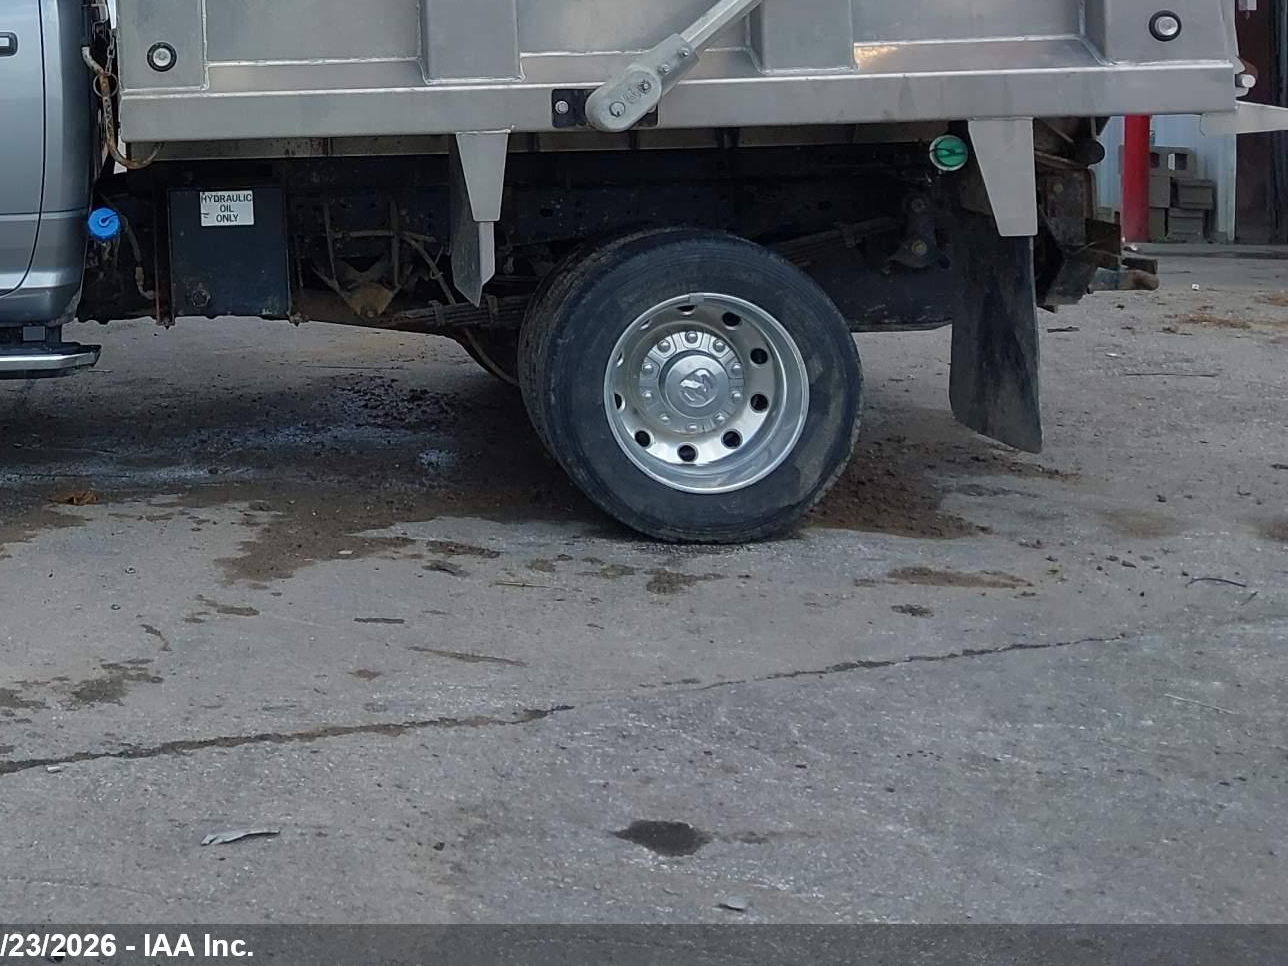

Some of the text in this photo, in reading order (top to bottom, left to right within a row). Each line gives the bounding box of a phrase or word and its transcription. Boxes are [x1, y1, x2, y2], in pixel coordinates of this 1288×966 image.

[201, 194, 252, 202] HYDRAULIC
[219, 204, 234, 213] OIL
[216, 214, 239, 223] ONLY
